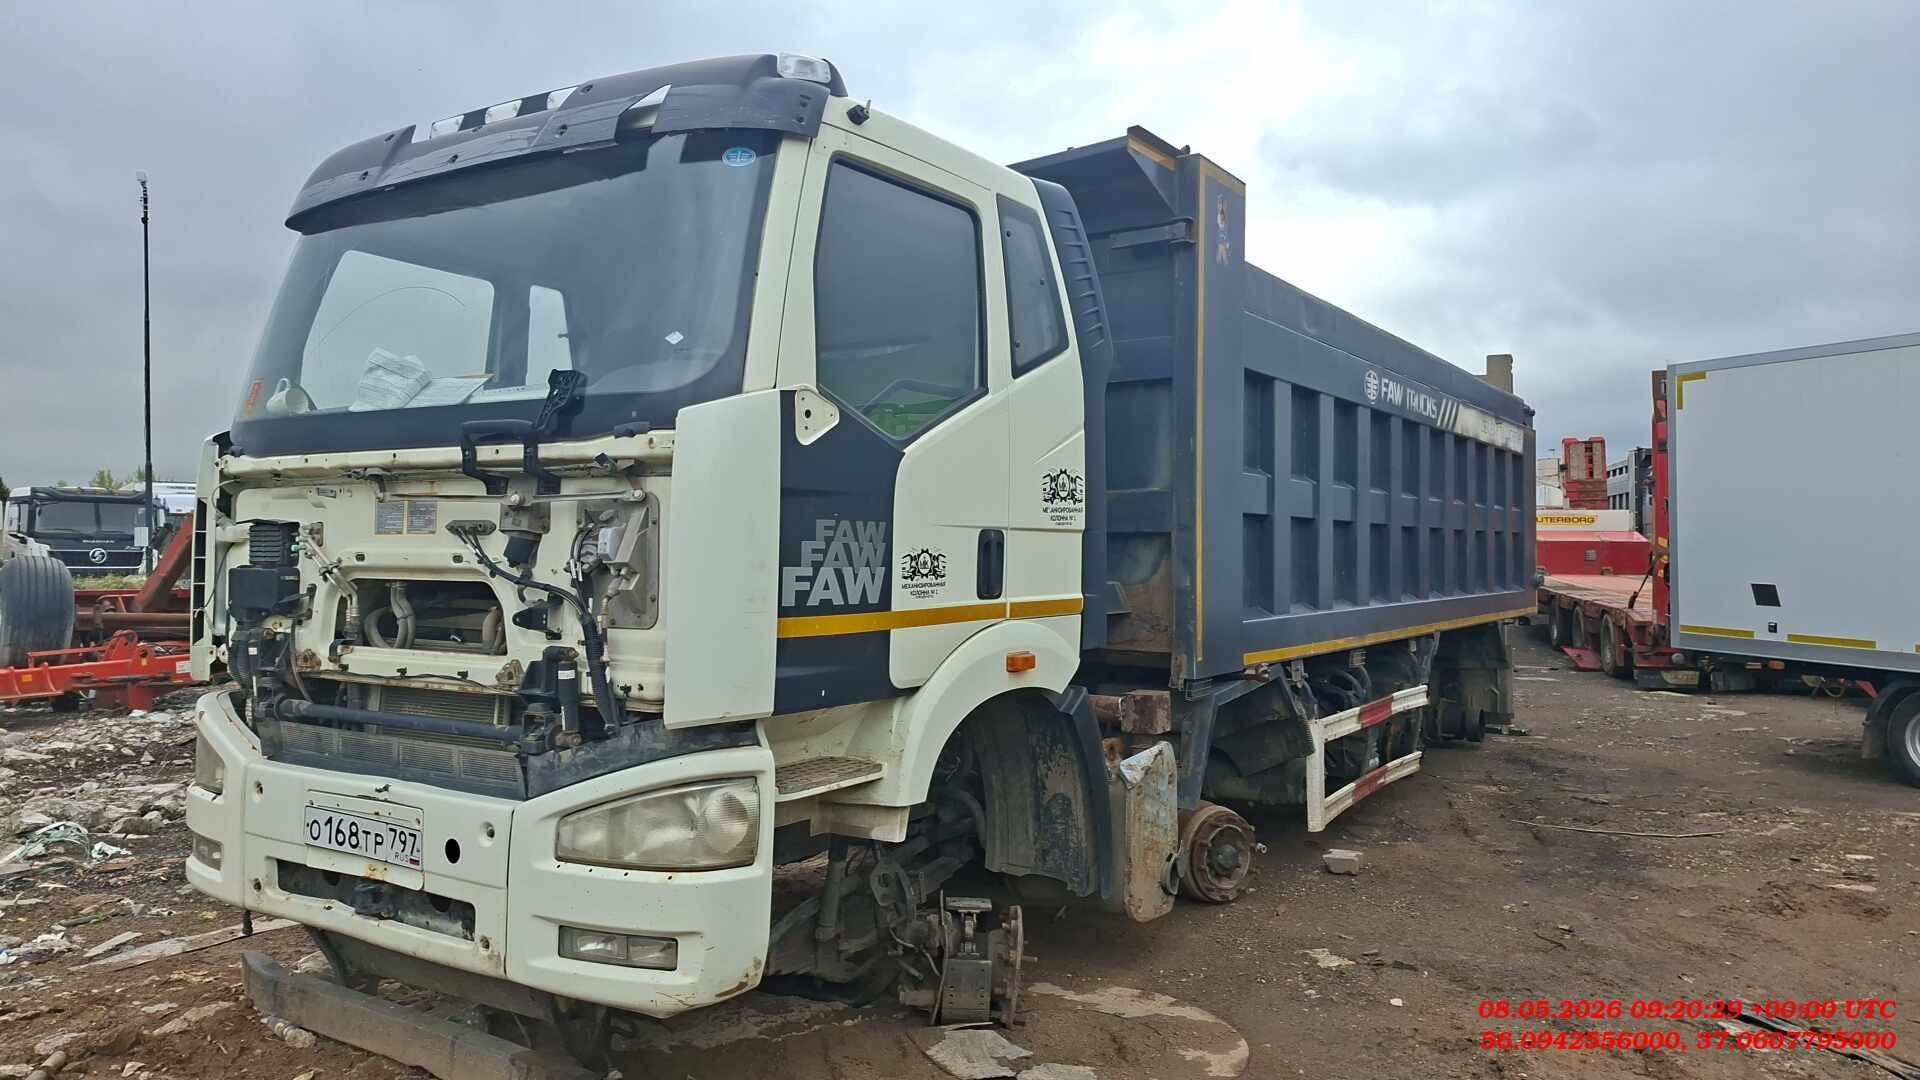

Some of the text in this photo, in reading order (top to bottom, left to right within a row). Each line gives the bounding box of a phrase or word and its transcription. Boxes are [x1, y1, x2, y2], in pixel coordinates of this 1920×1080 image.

[1381, 377, 1404, 407] FAW
[816, 519, 887, 549] FAW
[801, 541, 887, 574] FAW
[782, 566, 886, 606] FAW
[388, 827, 418, 856] 797
[394, 851, 409, 863] RUS
